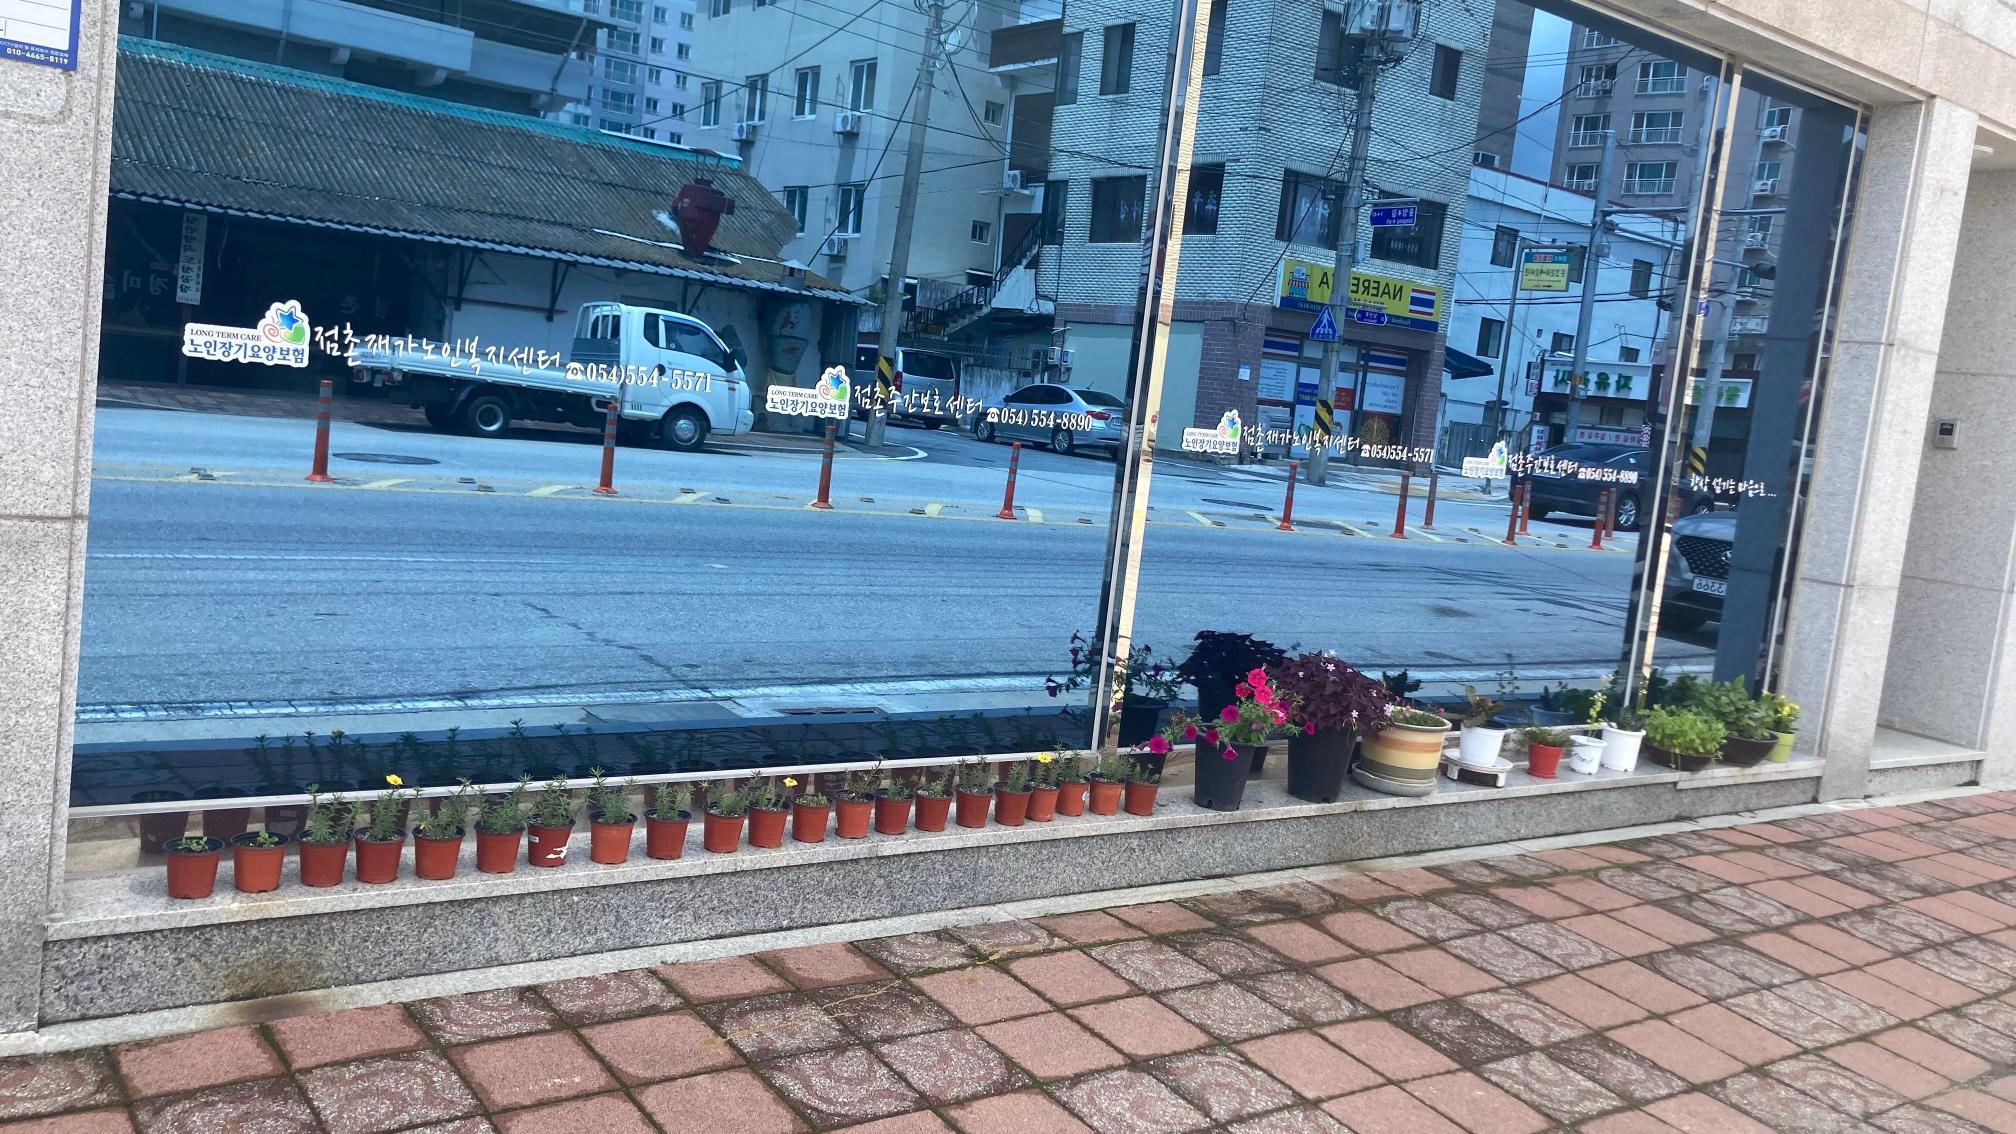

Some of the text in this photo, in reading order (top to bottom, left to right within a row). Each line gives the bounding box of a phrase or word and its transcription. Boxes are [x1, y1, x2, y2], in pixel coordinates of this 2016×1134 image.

[7, 48, 68, 64] 010-4665-8119
[190, 328, 262, 342] LONG TERM CARE
[188, 338, 305, 364] 노인장기요양보험
[586, 362, 713, 393] 054)554-5571
[769, 396, 847, 417] 노인장기요양보험
[1185, 437, 1238, 452] 노인장기요양보험
[1689, 472, 1711, 492] 항상
[1711, 477, 1736, 494] 섬기는
